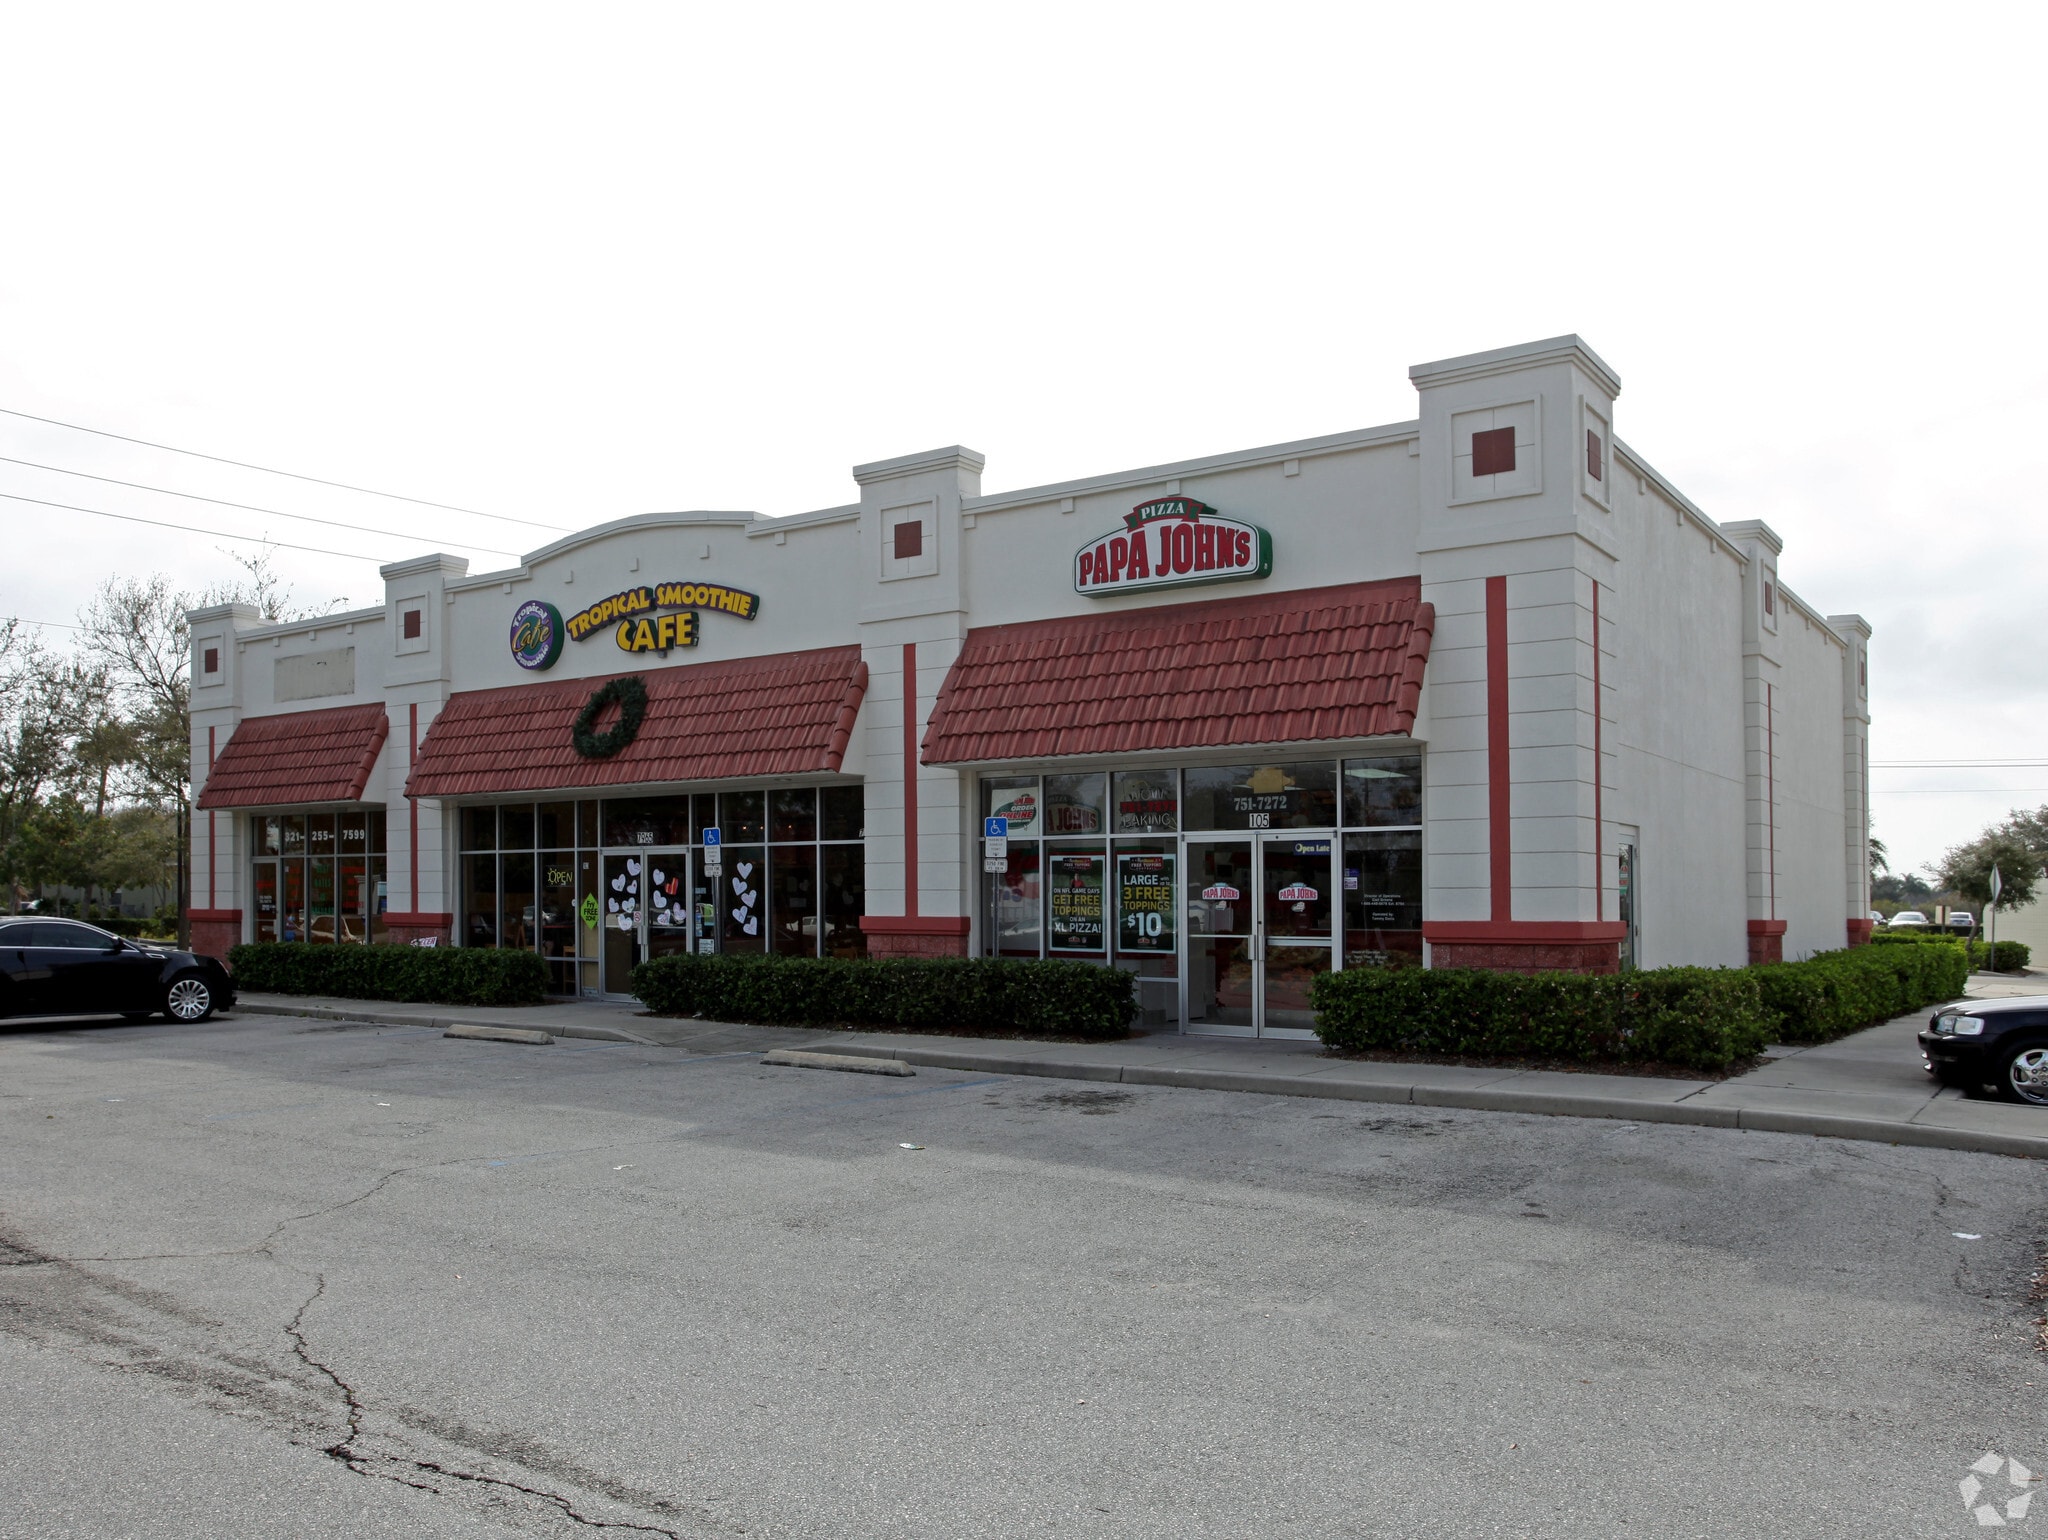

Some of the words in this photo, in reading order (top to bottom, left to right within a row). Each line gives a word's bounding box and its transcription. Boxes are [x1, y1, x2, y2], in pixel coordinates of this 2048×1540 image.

[1140, 502, 1184, 519] PIZZA
[1080, 530, 1150, 586] PAPA
[513, 603, 549, 628] Tropical
[566, 588, 651, 639] TROPICAL
[656, 585, 752, 617] SMOOTHIE
[615, 612, 693, 652] CAFE
[516, 644, 550, 667] Smoothie
[1233, 796, 1288, 811] 751-7272
[999, 811, 1034, 819] ONLINE
[1123, 813, 1171, 828] BAKING
[1250, 814, 1269, 827] 105
[343, 829, 365, 840] 7599
[1295, 843, 1315, 854] Open
[547, 867, 573, 884] OPEN
[1124, 874, 1159, 886] LARGE
[1123, 887, 1132, 900] 3
[1136, 887, 1170, 900] FREE
[1203, 888, 1218, 899] PAPA
[1279, 889, 1295, 899] PAPA
[587, 900, 595, 910] Fry
[1053, 895, 1074, 905] GET
[1075, 895, 1099, 905] FREE
[1124, 901, 1170, 911] TOPPINGS
[584, 908, 598, 916] FREE
[1054, 906, 1100, 916] TOPPINGS
[1054, 922, 1067, 933] XL
[1070, 922, 1102, 934] PIZZA!
[1128, 912, 1162, 937] $10
